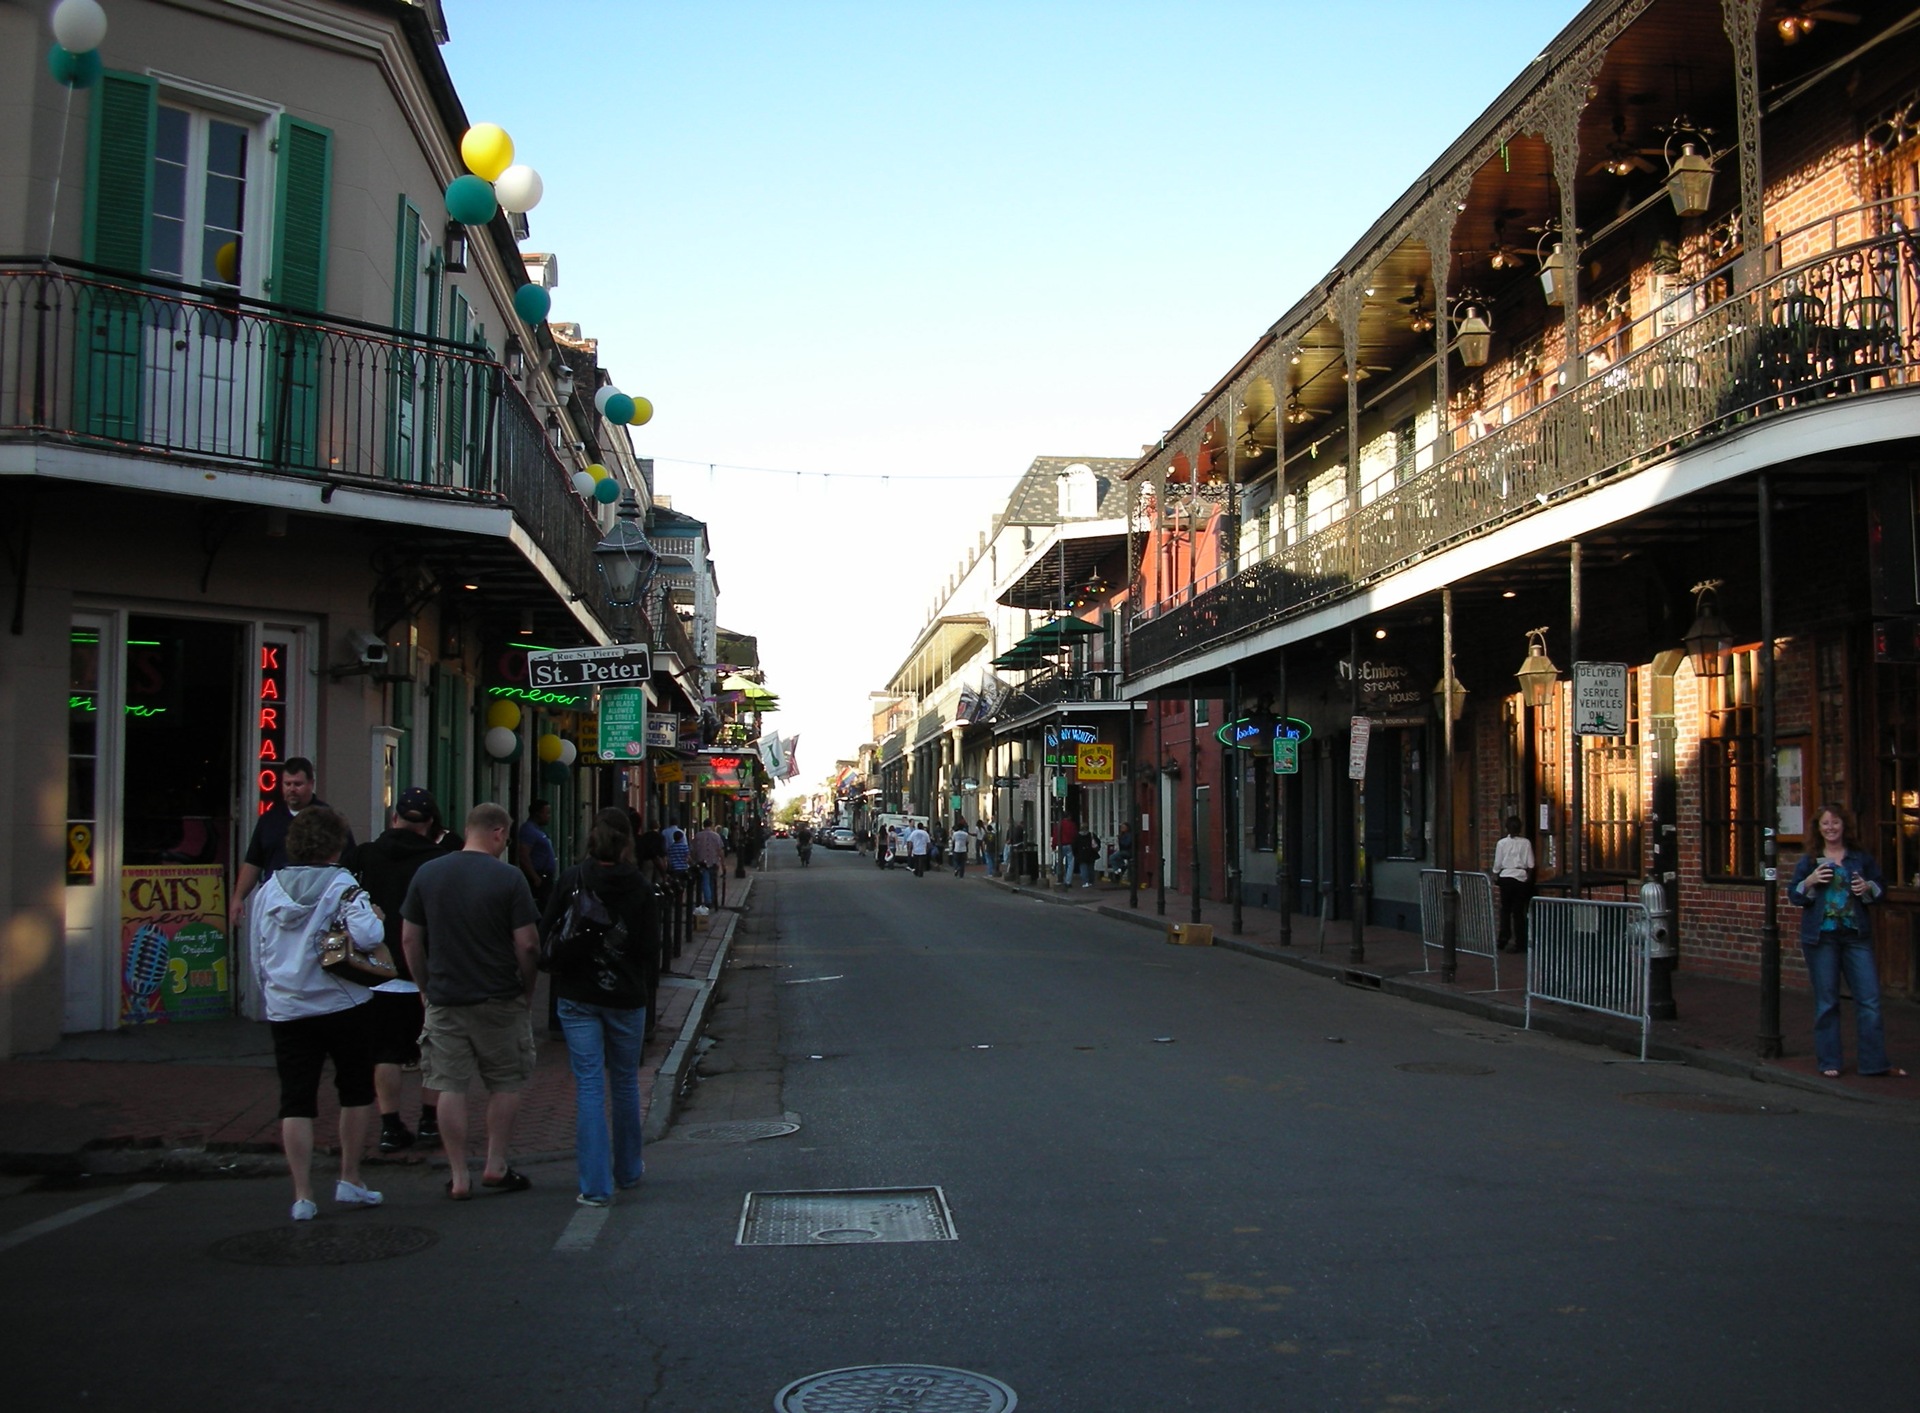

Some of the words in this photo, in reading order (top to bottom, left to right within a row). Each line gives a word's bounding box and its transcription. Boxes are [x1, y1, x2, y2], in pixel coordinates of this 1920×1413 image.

[557, 653, 574, 661] Rue
[593, 649, 620, 658] Pierre
[536, 665, 569, 684] St.
[580, 662, 642, 681] Peter
[1362, 661, 1408, 680] Embers
[1580, 667, 1622, 677] DELIVERY
[1363, 681, 1400, 692] STEAK
[487, 686, 580, 705] meow
[1388, 691, 1421, 703] HOUSE
[1583, 688, 1619, 698] SERVICE
[1579, 699, 1623, 709] VEHICLES
[648, 720, 676, 732] GIFTS
[129, 877, 201, 911] CATS
[121, 913, 225, 924] meow
[174, 933, 195, 942] Home
[198, 934, 208, 944] of
[209, 930, 224, 940] The
[181, 943, 215, 957] Original
[169, 957, 188, 993] 3
[212, 956, 229, 992] 1
